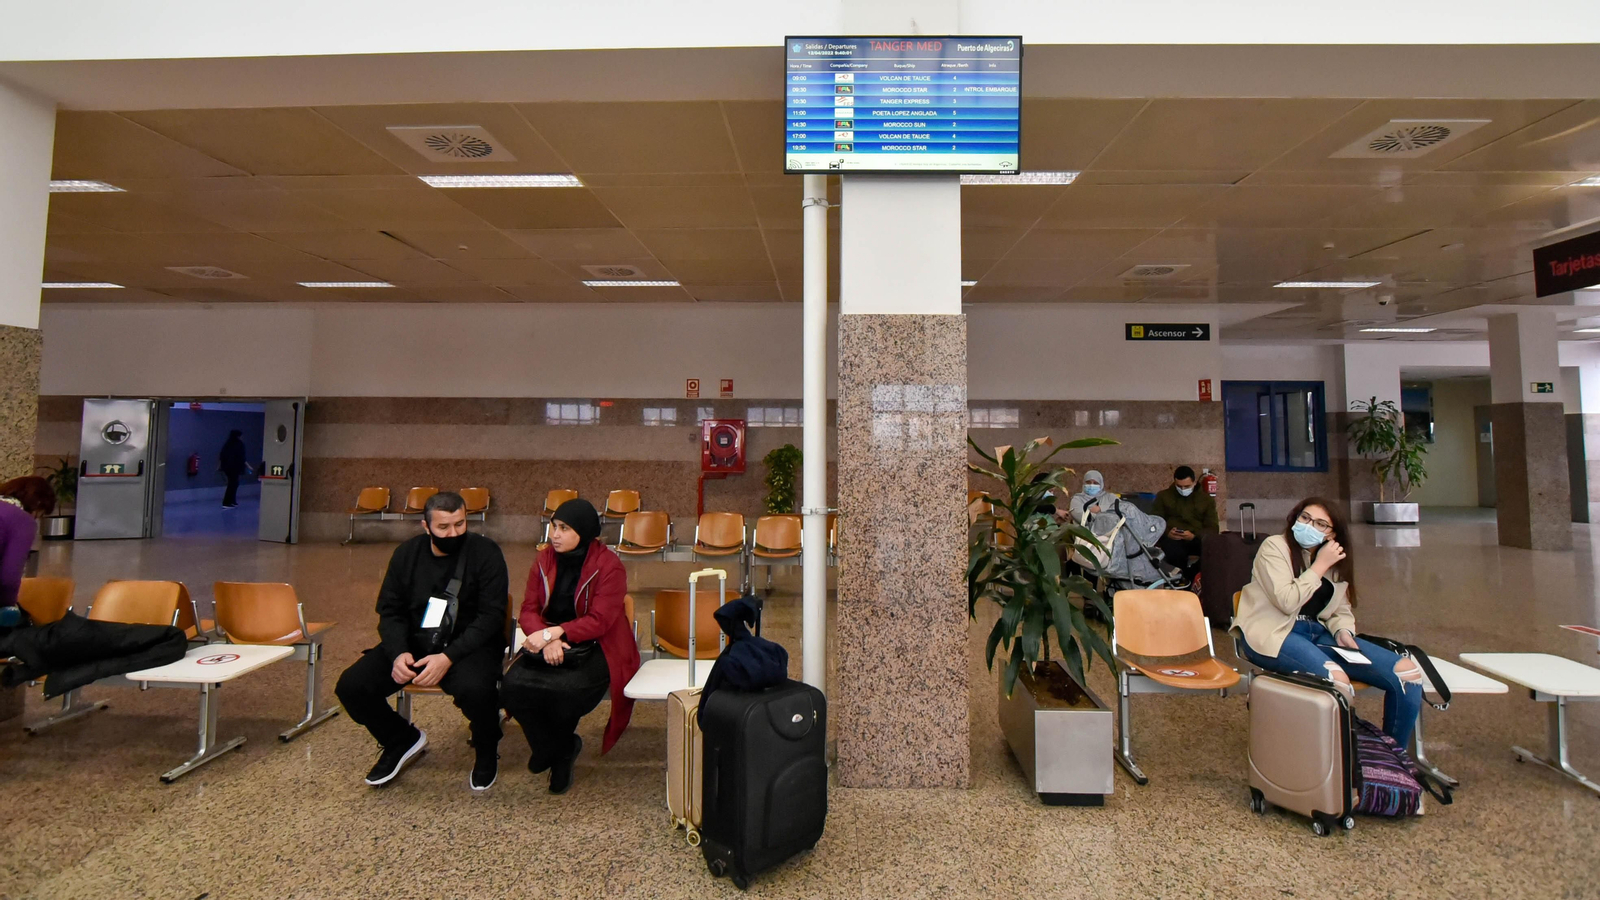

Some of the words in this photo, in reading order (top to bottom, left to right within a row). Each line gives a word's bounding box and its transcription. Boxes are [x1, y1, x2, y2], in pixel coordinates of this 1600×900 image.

[870, 41, 913, 52] TANGER
[917, 41, 942, 52] MED
[984, 44, 1009, 53] Algeciras
[1550, 254, 1600, 276] Tarjetas
